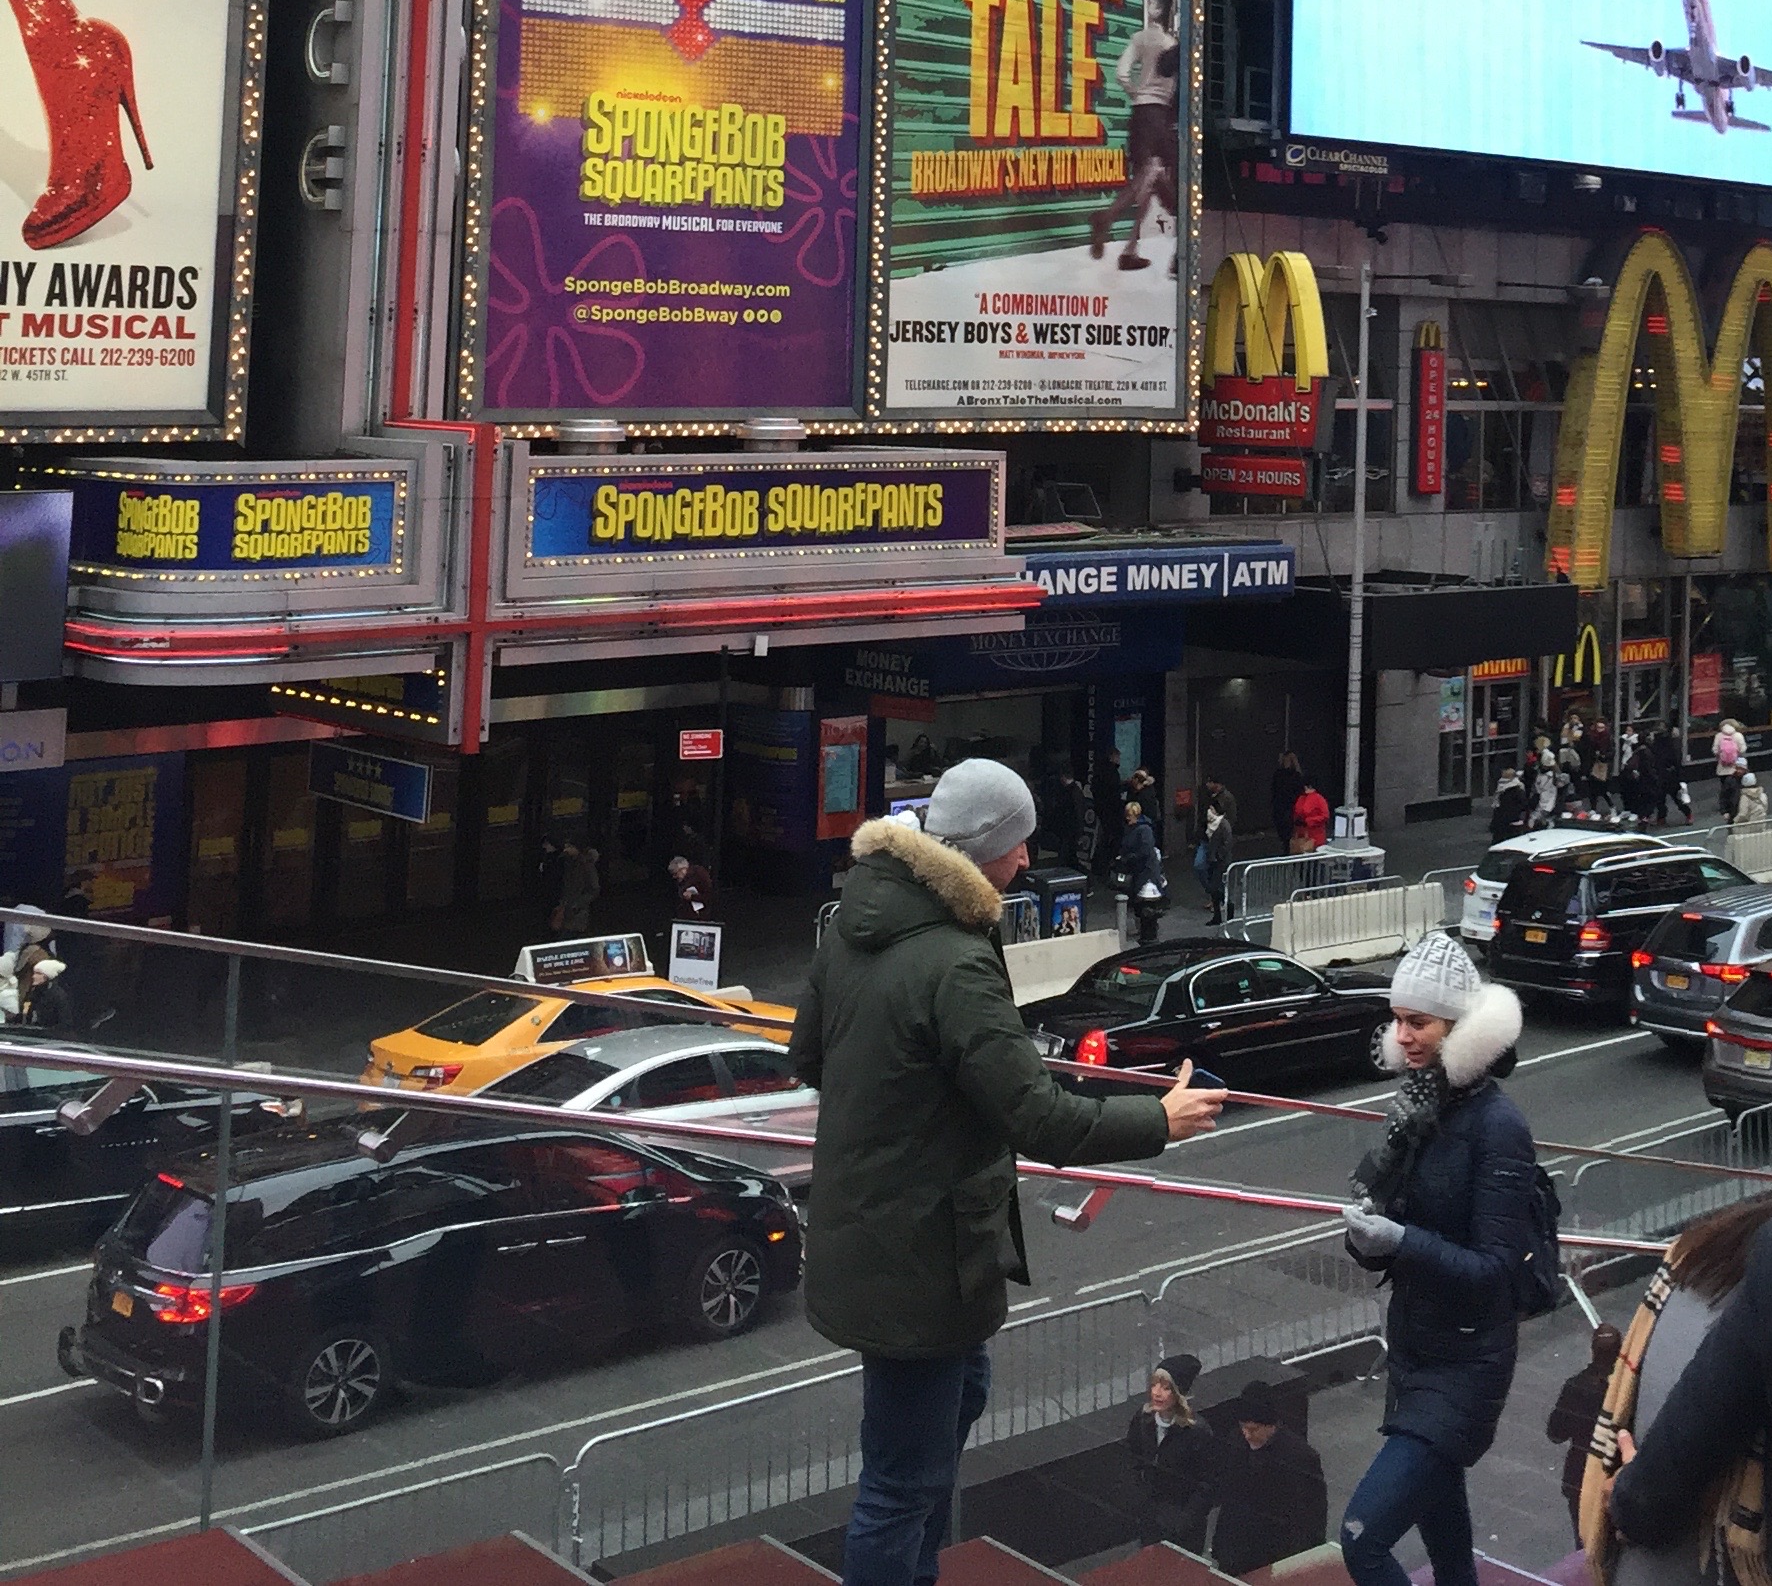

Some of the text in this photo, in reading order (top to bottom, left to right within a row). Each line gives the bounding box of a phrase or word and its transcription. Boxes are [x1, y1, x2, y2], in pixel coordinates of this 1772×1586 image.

[912, 149, 1126, 197] BROADWAY'S NEW HIT MUSICAL
[584, 213, 783, 233] THE BROADWAY MUSICAL FOR EVERYONE
[44, 263, 199, 310] AWARDS
[564, 277, 790, 298] SpongeBobBroadway.com
[574, 305, 738, 325] @SpongeBobBway
[21, 314, 196, 339] MUSICAL
[889, 321, 1122, 346] JERSEY BOYS & WEST SIDE
[957, 396, 1122, 405] ABronxTaleTheMusical.com
[1201, 399, 1310, 423] McDonald's
[1216, 426, 1290, 441] Restaurant
[1203, 468, 1300, 486] OPEN 24 HOURS
